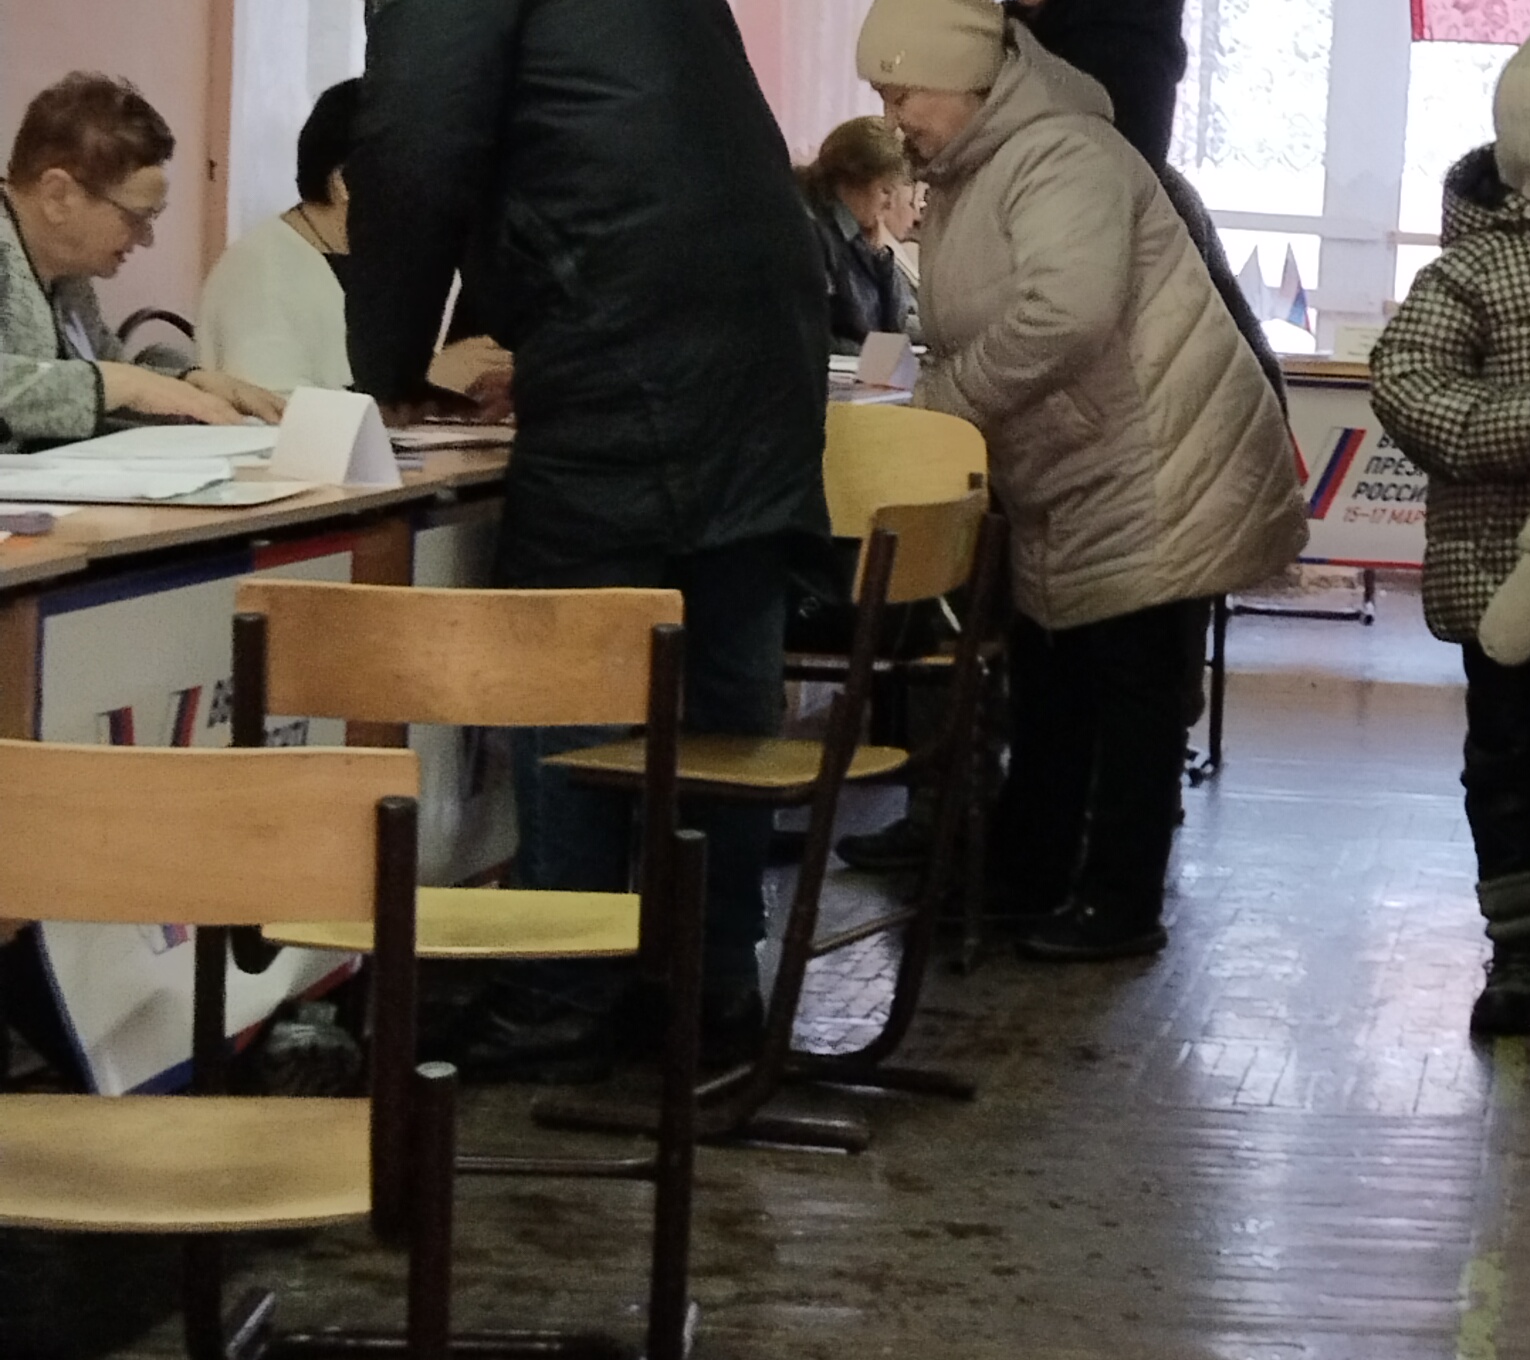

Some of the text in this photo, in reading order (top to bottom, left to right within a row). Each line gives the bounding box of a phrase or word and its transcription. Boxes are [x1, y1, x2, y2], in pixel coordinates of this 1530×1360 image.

[1364, 455, 1424, 477] ПРЕЗ
[1352, 481, 1428, 502] РОССИ
[1387, 509, 1428, 525] МАР
